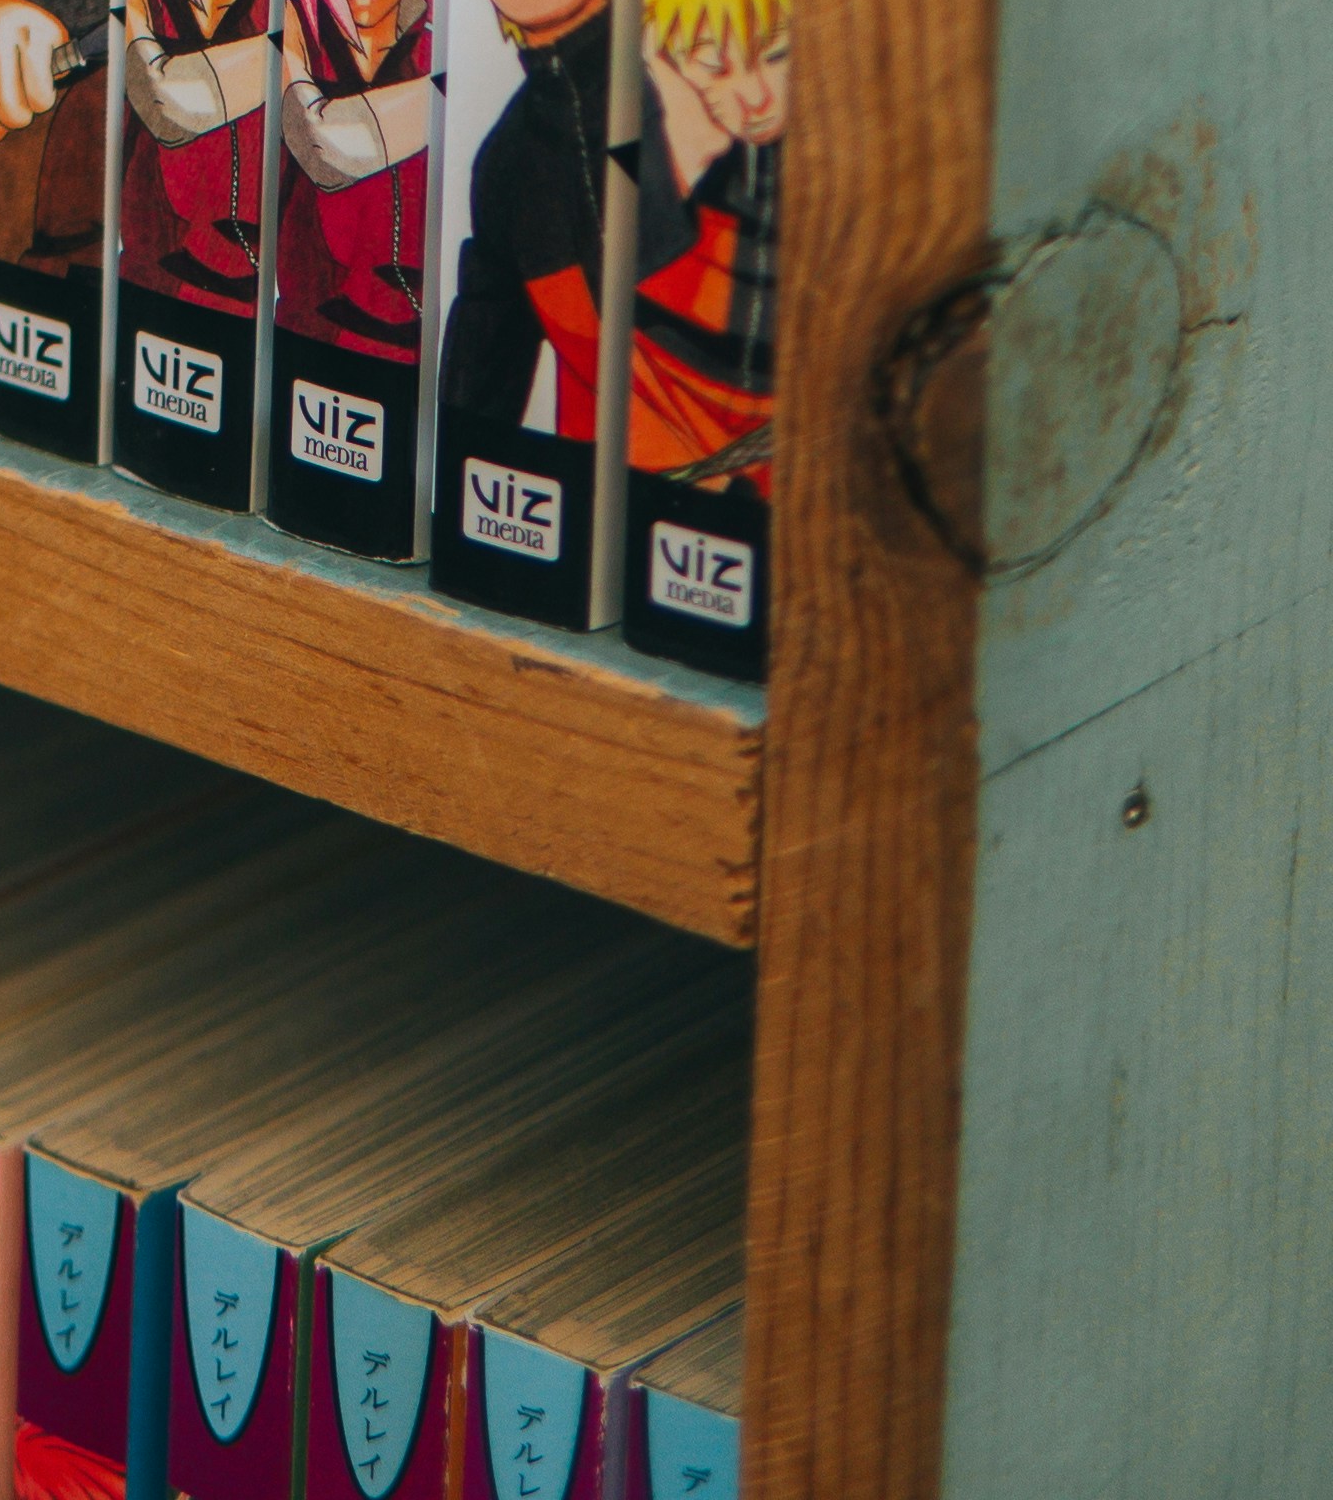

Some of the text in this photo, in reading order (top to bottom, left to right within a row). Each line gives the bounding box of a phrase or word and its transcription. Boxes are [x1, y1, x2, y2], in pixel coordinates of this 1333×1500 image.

[56, 1220, 84, 1352] デルレイ
[210, 1289, 240, 1423] デルレイ
[357, 1350, 391, 1481] デルレイ
